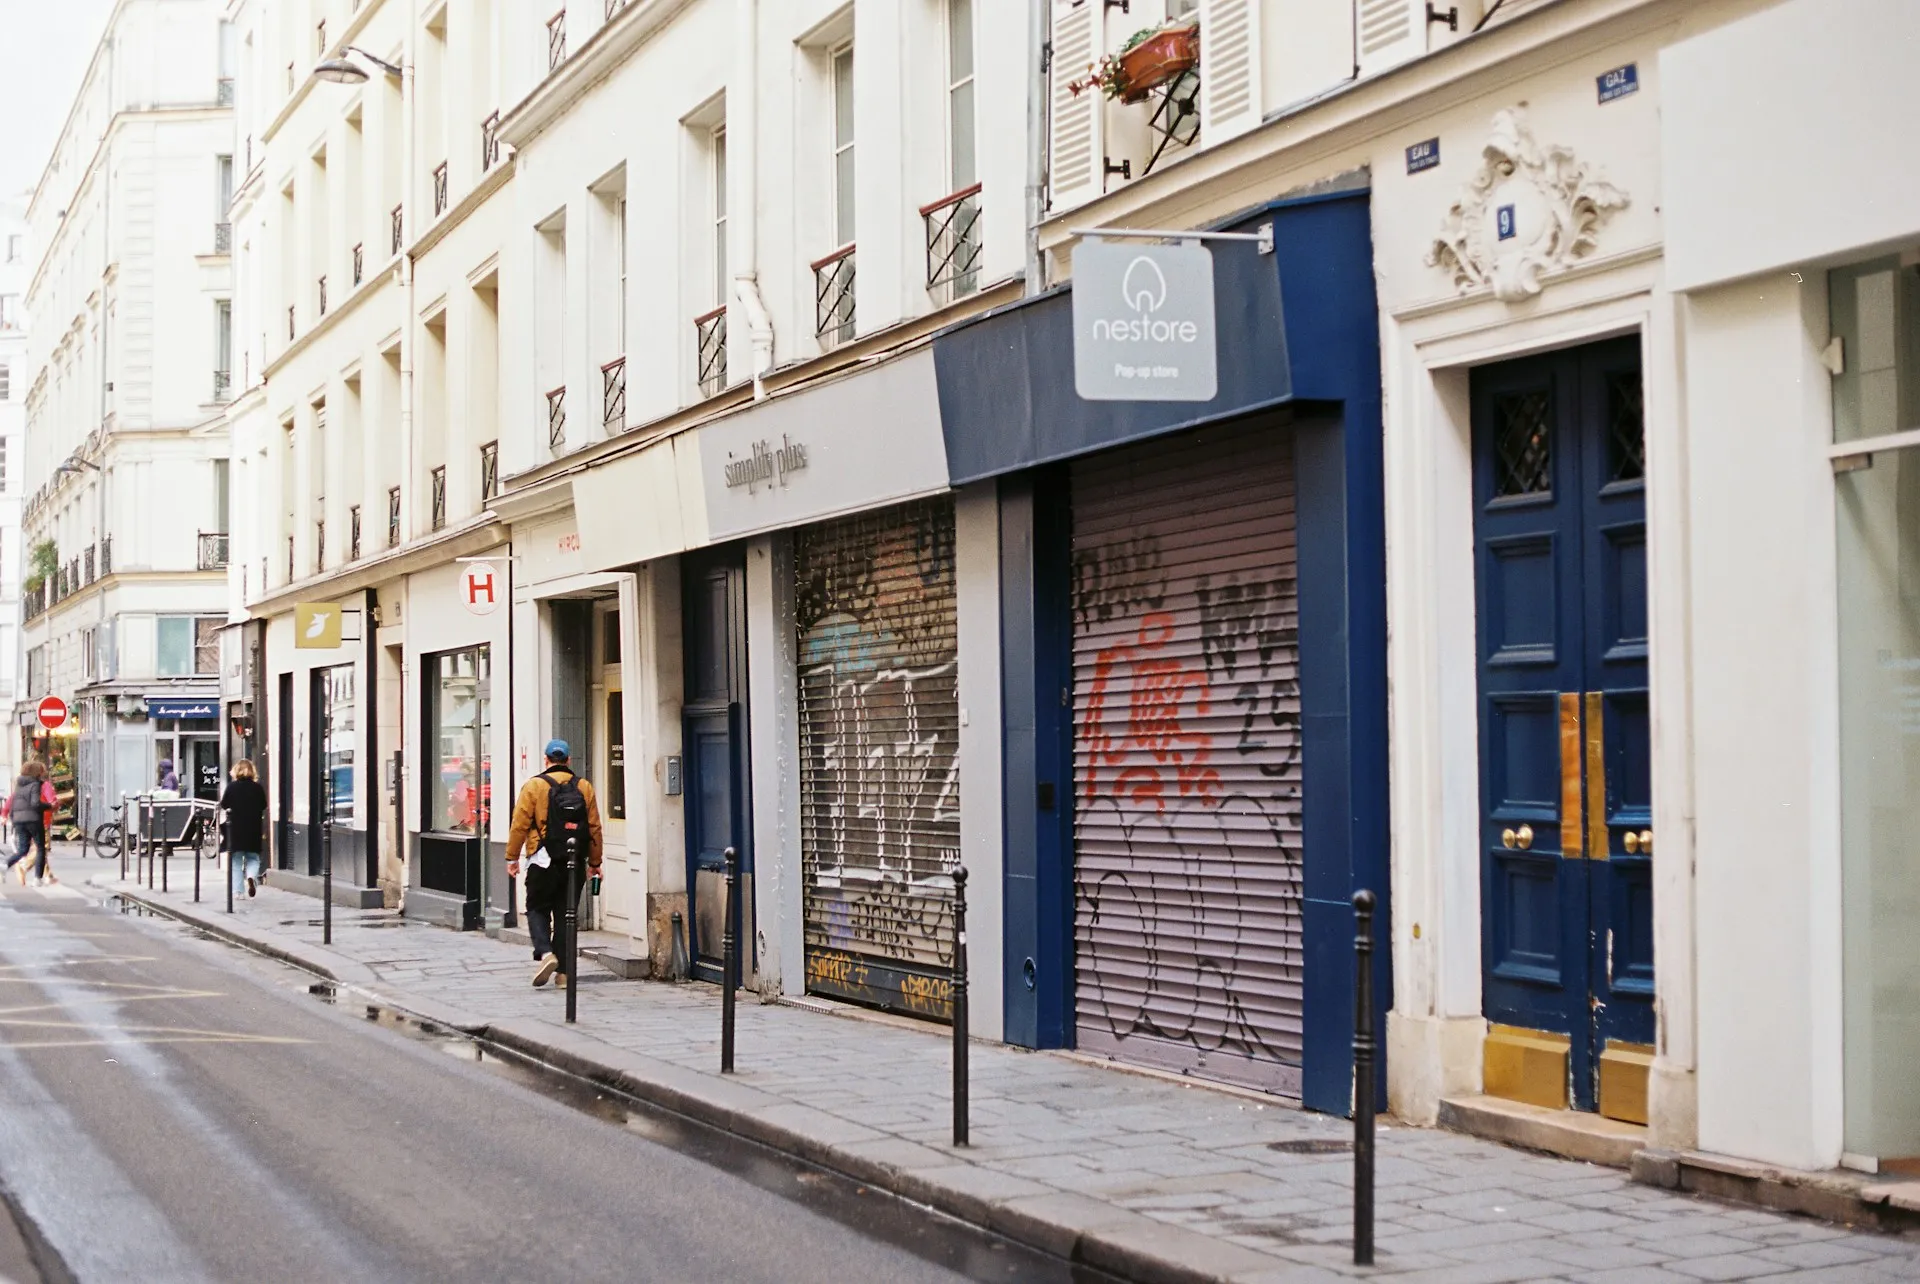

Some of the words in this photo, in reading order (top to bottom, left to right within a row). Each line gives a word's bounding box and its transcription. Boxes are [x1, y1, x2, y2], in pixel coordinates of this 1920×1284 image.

[1605, 68, 1627, 88] GAZ
[1412, 143, 1430, 160] EAU
[1499, 211, 1510, 234] 9
[1092, 313, 1198, 342] nestore
[1114, 363, 1151, 379] Pop-up
[1152, 365, 1179, 378] store
[724, 439, 773, 495] simplify
[776, 432, 808, 487] plus
[467, 573, 494, 604] H
